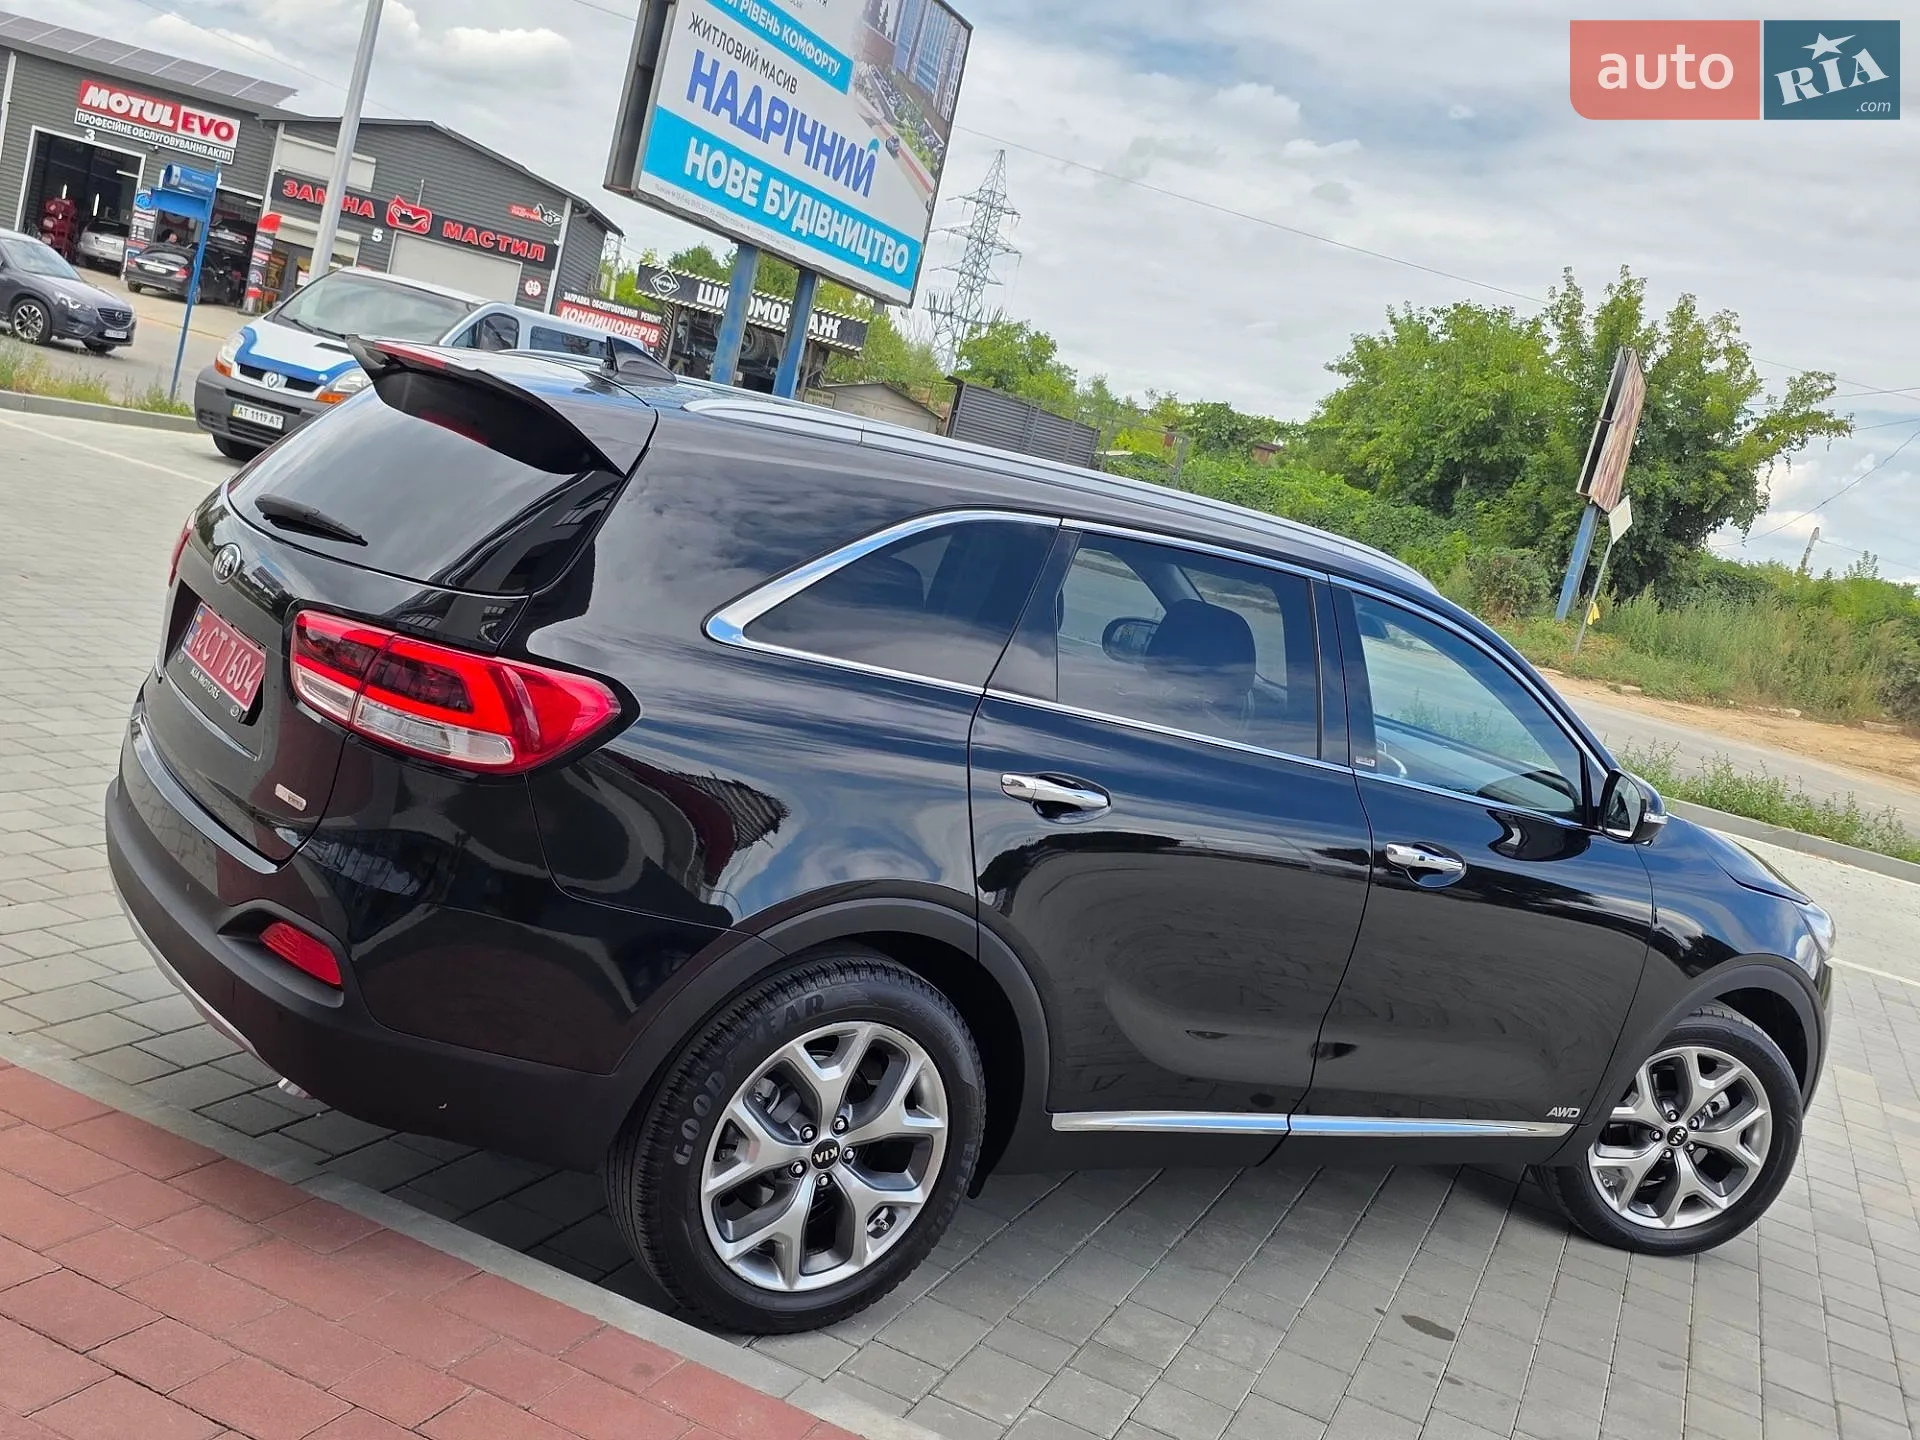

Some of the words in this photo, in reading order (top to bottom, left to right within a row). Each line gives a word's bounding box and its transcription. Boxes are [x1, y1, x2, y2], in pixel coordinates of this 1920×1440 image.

[688, 12, 758, 71] ЖИТЛОВИЙ
[759, 58, 798, 94] МАСИВ
[740, 0, 780, 36] РІВЕНЬ
[781, 24, 841, 77] КОМФОРТУ
[77, 111, 132, 135] ПРОФЕСІЙНЕ
[132, 125, 208, 154] ОБСЛУГОВУВАННЯ
[207, 146, 231, 161] АКПП
[82, 85, 175, 127] MOTUL
[181, 111, 234, 141] EVO
[84, 128, 96, 142] 3
[686, 49, 880, 198] НАДРІЧНИЙ
[282, 179, 376, 219] ЗАМНА
[442, 220, 546, 262] МАСТИЛ
[684, 136, 763, 209] НОВЕ
[762, 172, 909, 274] БУДІВНИЦТВО
[372, 228, 384, 243] 5
[560, 306, 660, 344] КОНДИЦІОНЕРІВ
[1545, 1106, 1581, 1118] AWD
[812, 1146, 838, 1163] KIA
